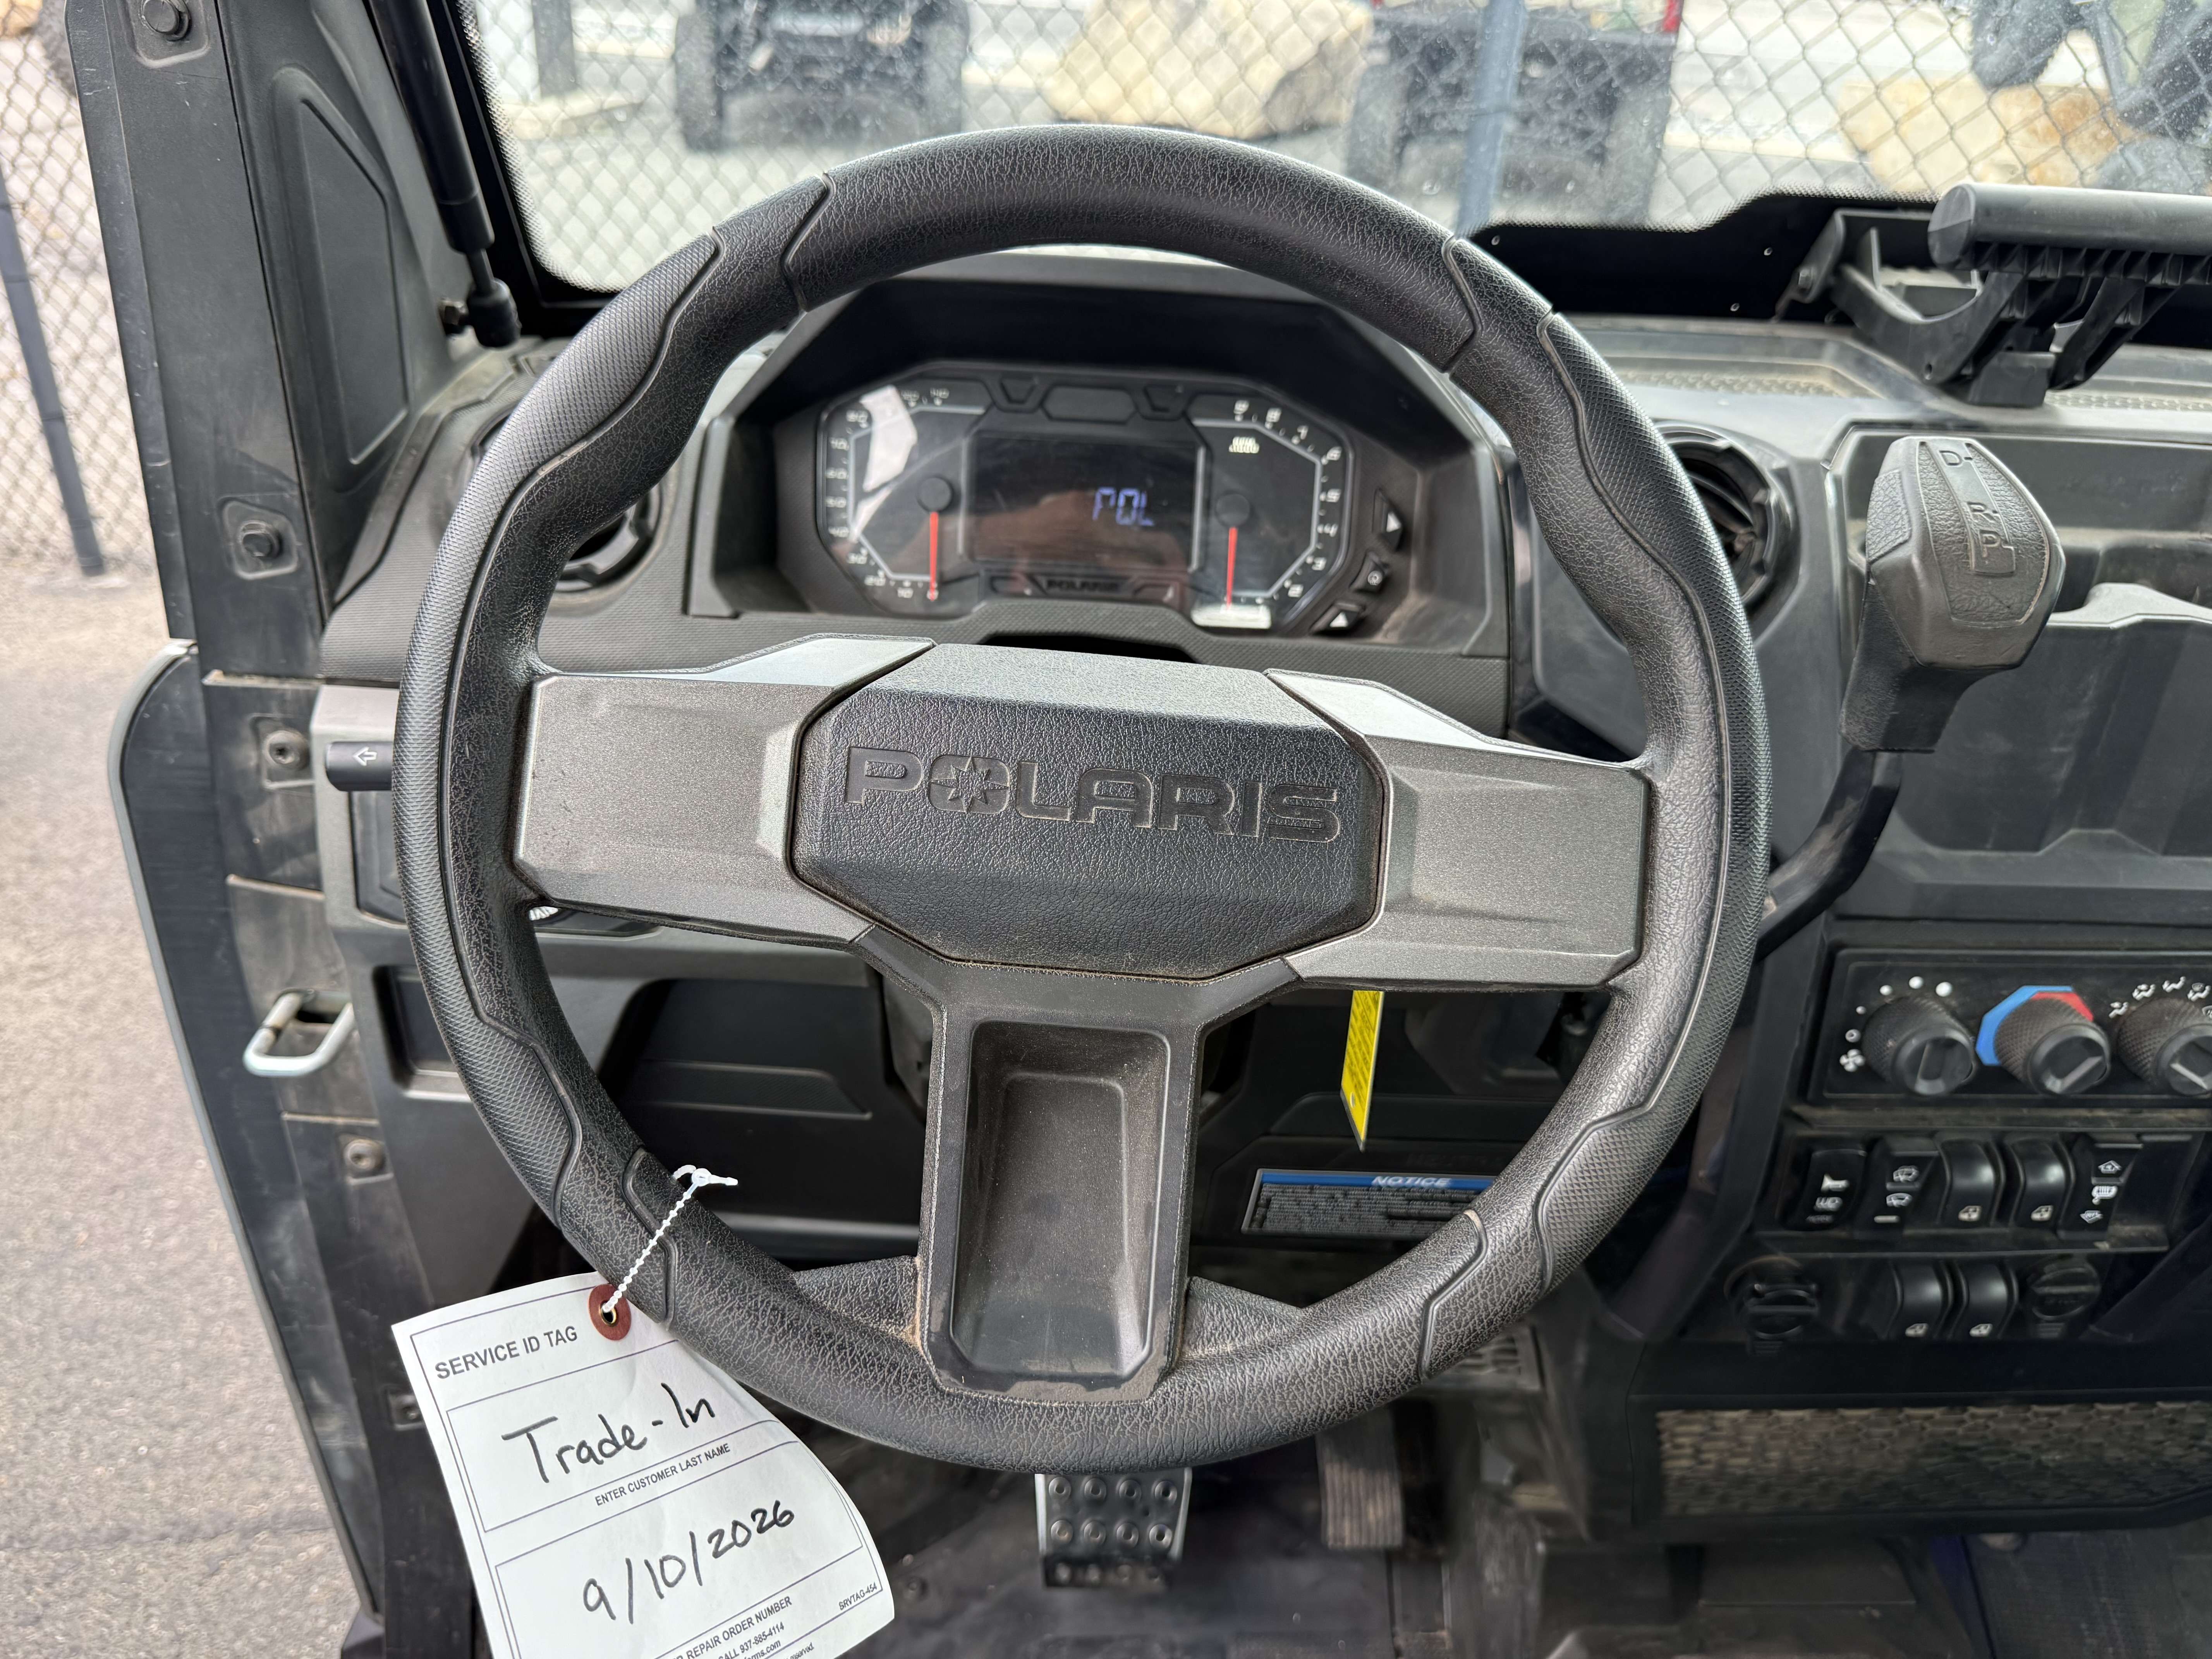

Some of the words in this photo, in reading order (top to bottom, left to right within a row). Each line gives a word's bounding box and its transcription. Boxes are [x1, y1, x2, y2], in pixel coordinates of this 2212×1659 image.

[1939, 450, 1963, 466] D
[1978, 529, 2001, 558] P
[845, 745, 1341, 843] POLARIS
[1371, 1176, 1452, 1188] NOTICE
[434, 1341, 520, 1379] SERVICE
[522, 1336, 540, 1353] ID
[543, 1326, 578, 1347] TAG
[595, 1486, 627, 1506] ENTER
[628, 1465, 678, 1492] CUSTOMER
[679, 1454, 703, 1471] LAST
[704, 1443, 730, 1461] NAME
[583, 1500, 795, 1625] 9/10/2026
[839, 1581, 877, 1611] SRVTAG-454
[686, 1635, 722, 1659] REPAIR
[722, 1617, 755, 1641] ORDER
[754, 1596, 792, 1623] NUMBER
[740, 1621, 785, 1653] 937-885-4114
